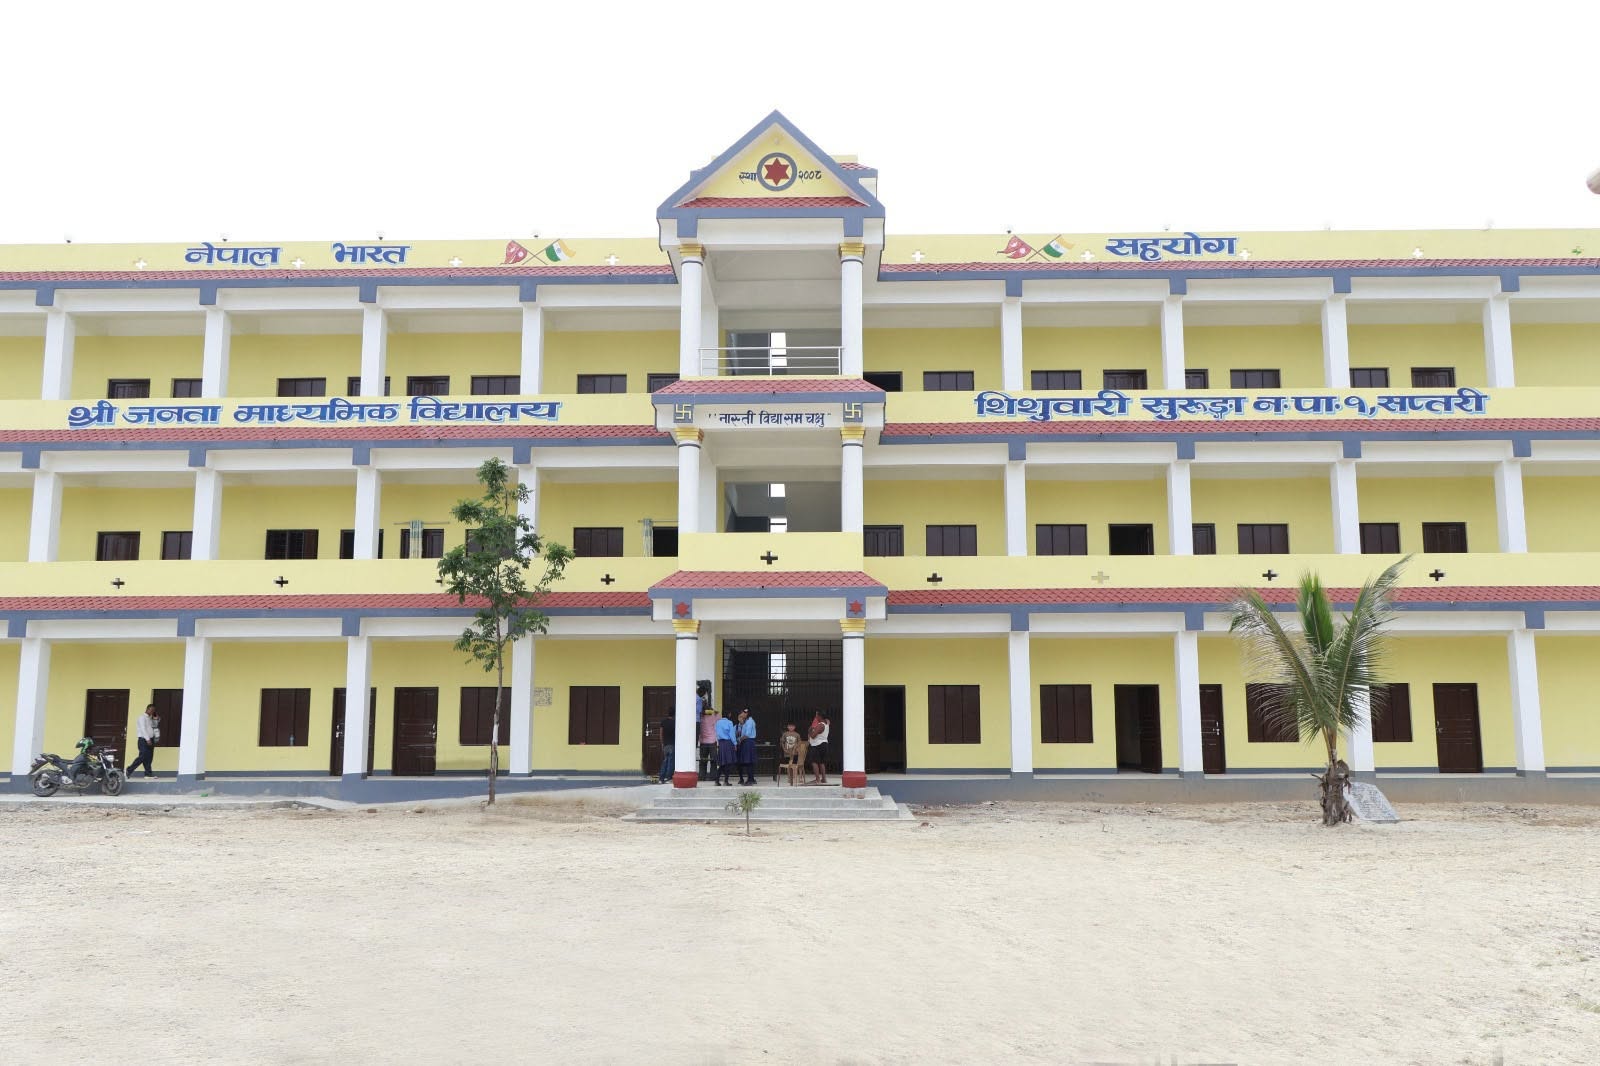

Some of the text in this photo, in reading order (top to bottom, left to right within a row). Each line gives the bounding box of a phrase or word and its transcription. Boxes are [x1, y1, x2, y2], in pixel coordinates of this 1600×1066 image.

[184, 242, 411, 267] नेपाल भारत
[1105, 231, 1238, 262] सहयोग
[68, 395, 561, 428] श्री जनता माध्यमिक विद्यालय
